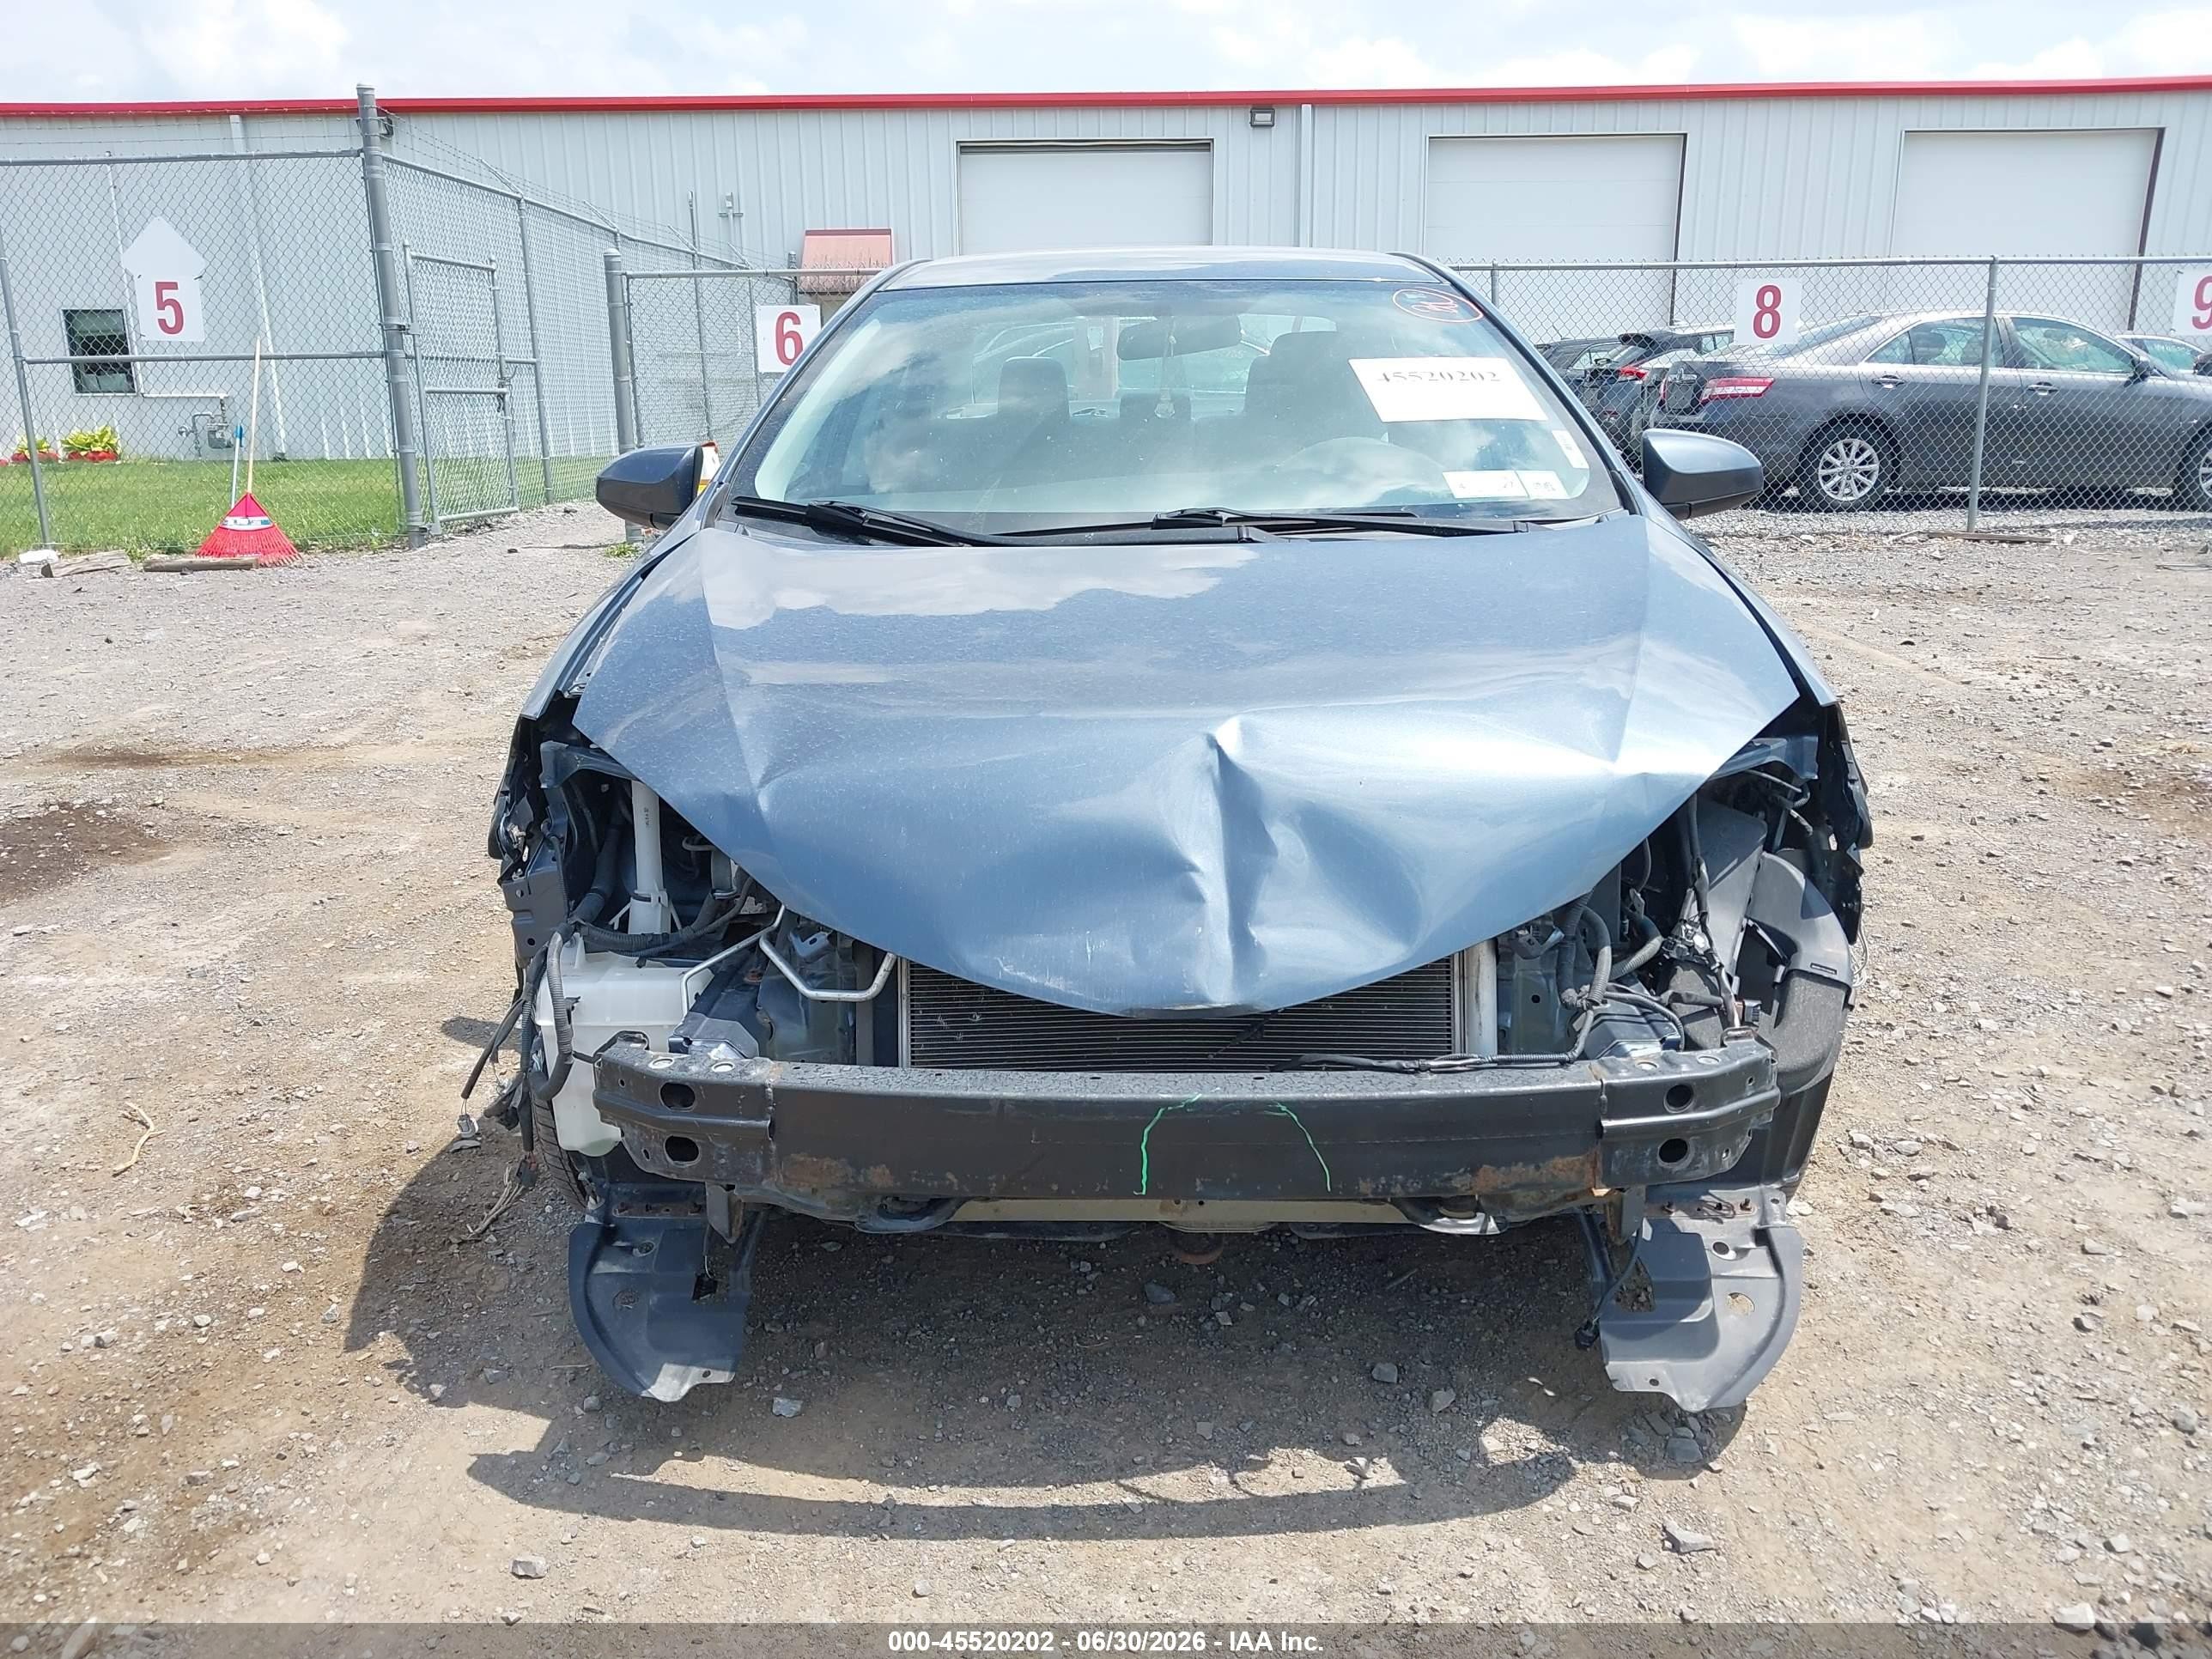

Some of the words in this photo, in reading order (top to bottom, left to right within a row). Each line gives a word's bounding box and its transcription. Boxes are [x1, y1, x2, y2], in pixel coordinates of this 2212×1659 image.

[154, 280, 185, 336] 5
[1753, 283, 1782, 339] 8
[774, 310, 804, 365] 6
[1377, 369, 1501, 383] 45520202
